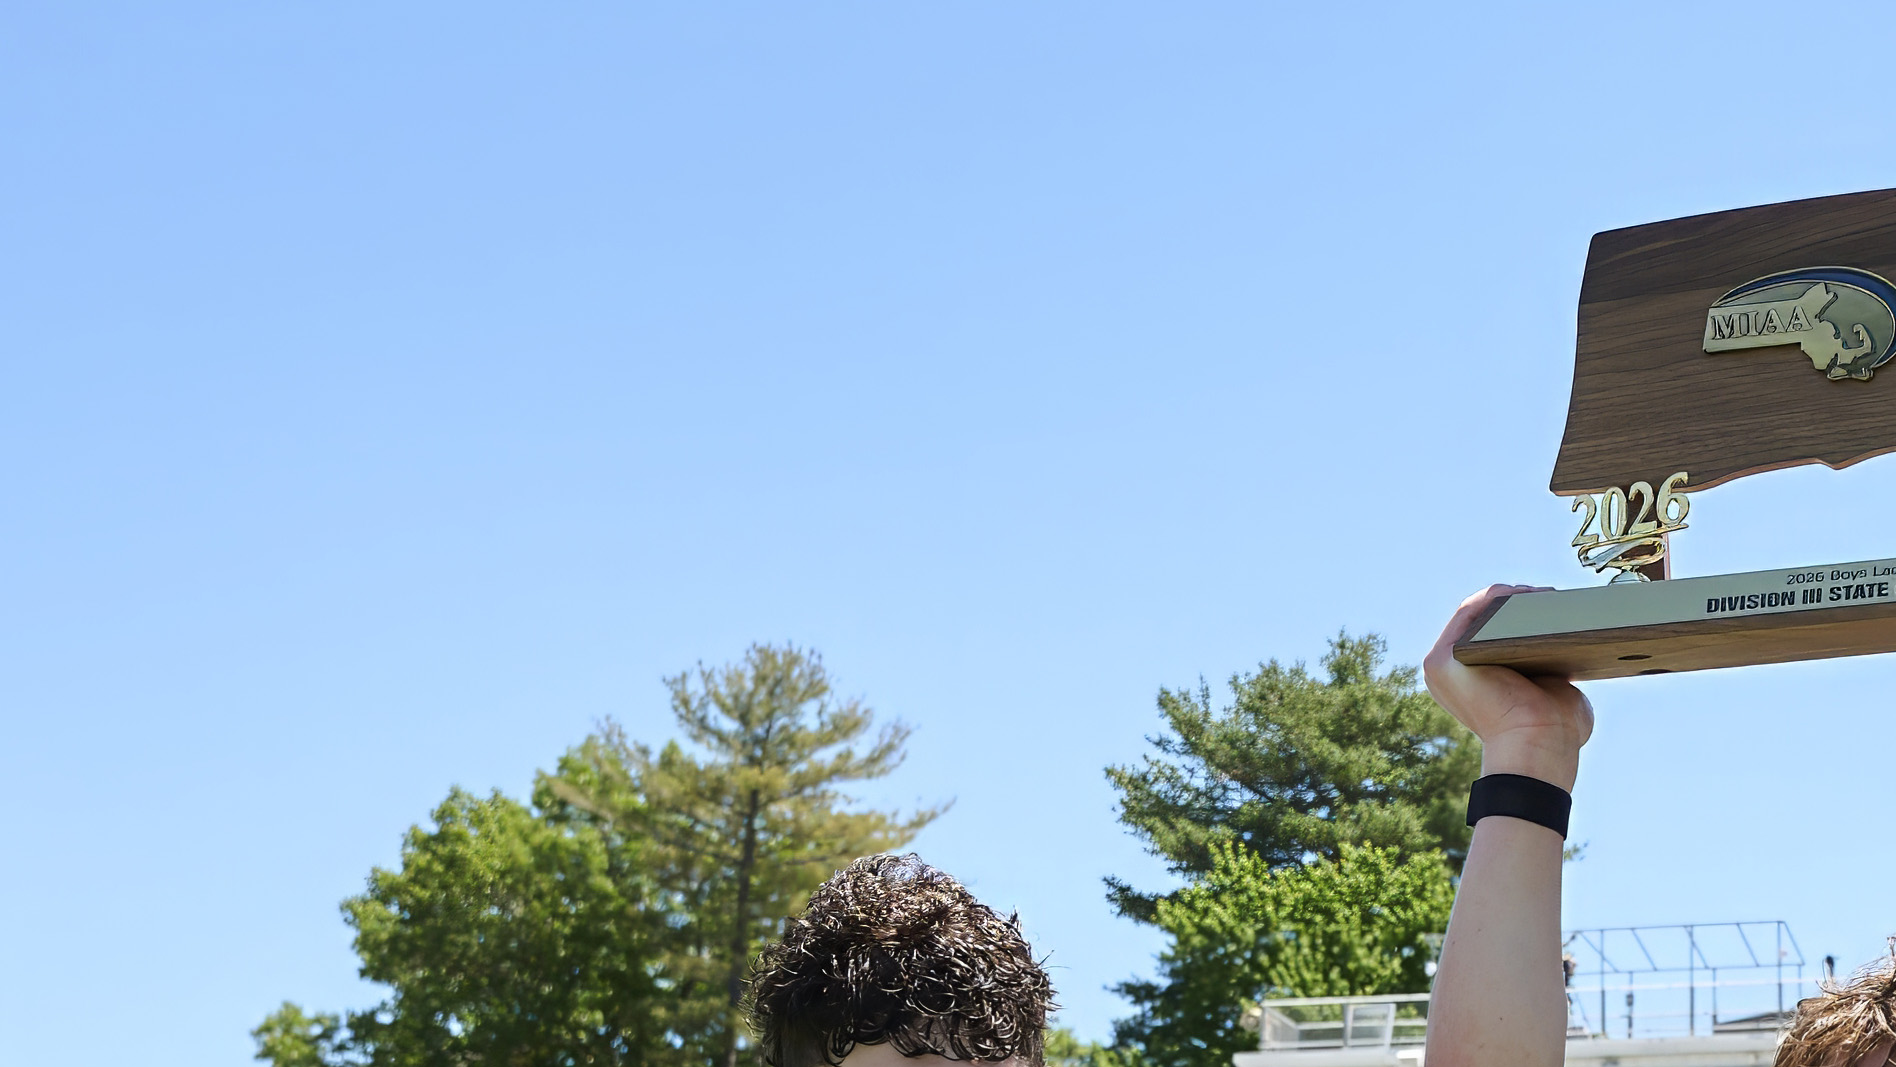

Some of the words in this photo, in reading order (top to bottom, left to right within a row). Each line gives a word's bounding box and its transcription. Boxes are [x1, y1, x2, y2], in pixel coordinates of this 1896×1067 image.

[1711, 305, 1814, 340] MIAA
[1571, 471, 1690, 547] 2026
[1786, 571, 1825, 585] 2026
[1830, 569, 1867, 581] Boys
[1706, 592, 1796, 613] DIVISION
[1802, 588, 1822, 604] III
[1829, 582, 1889, 601] STATE
